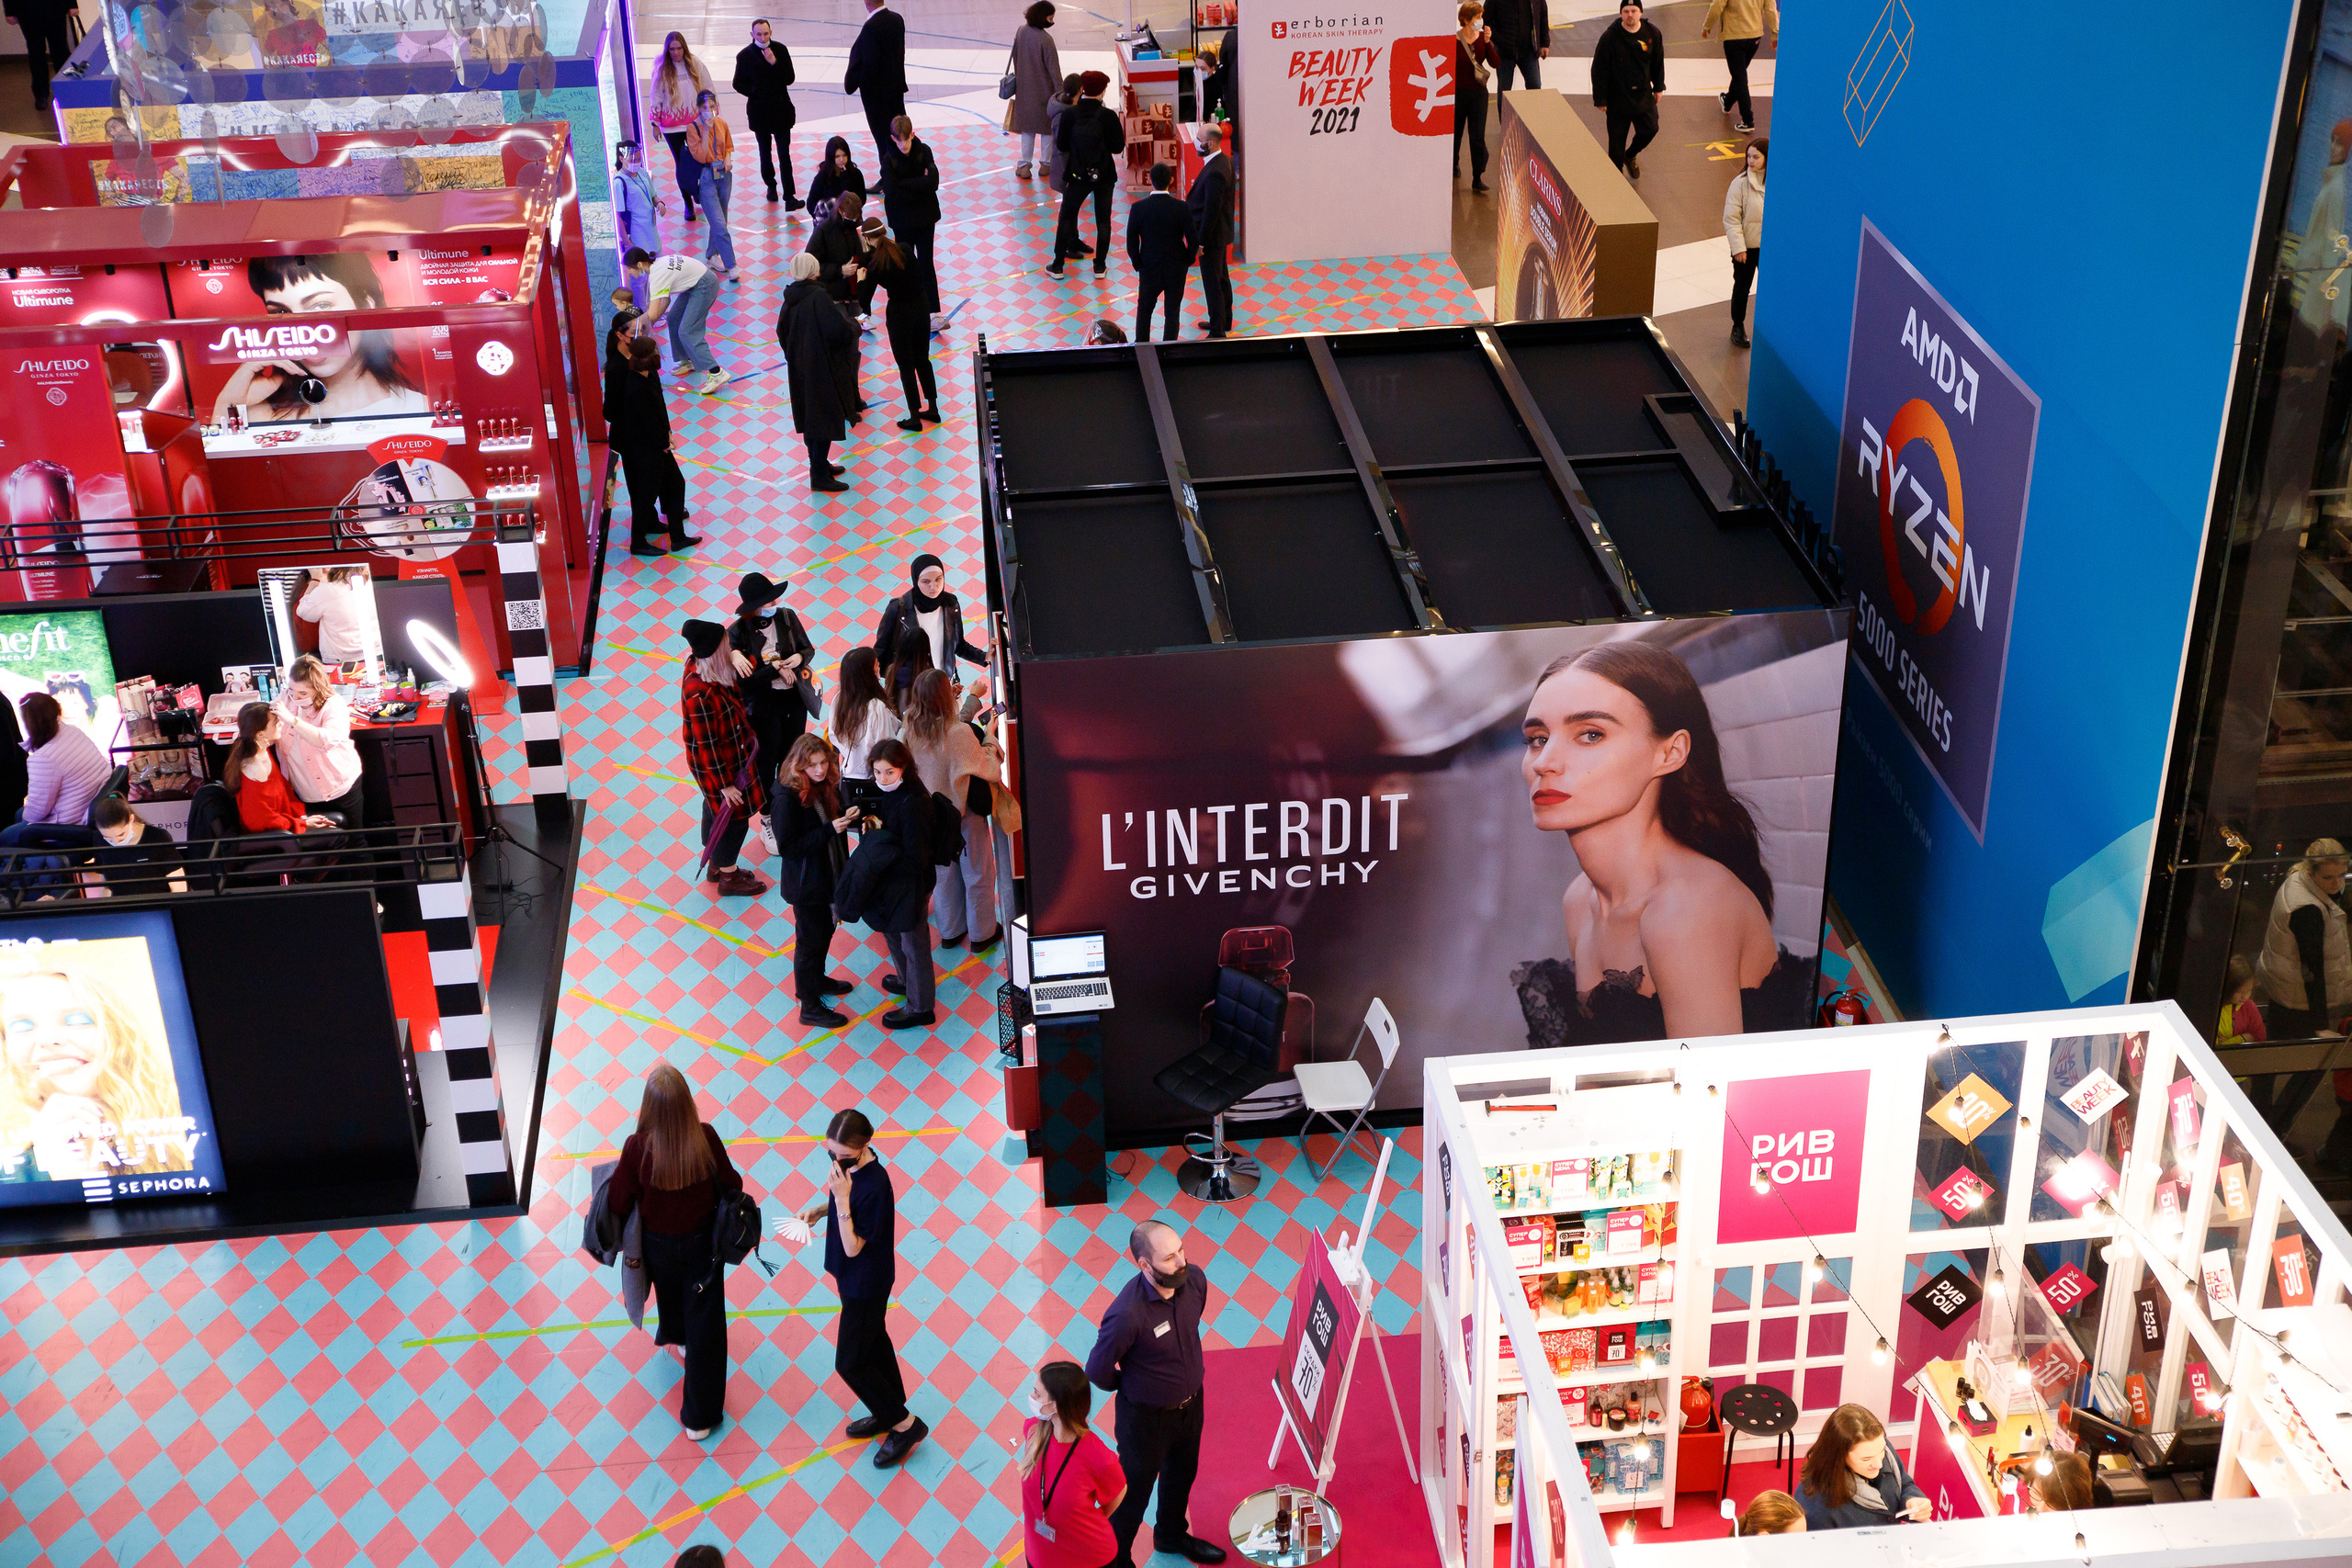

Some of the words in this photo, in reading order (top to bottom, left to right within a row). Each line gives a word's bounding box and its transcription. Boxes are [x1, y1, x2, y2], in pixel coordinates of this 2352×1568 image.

[1291, 14, 1384, 29] erborian
[1291, 31, 1323, 39] KOREAN
[1347, 28, 1384, 37] THERAPY
[1288, 47, 1383, 79] BEAUTY
[1298, 76, 1374, 107] WEEK
[1310, 107, 1360, 136] 2021
[1529, 158, 1562, 217] CLARINS
[418, 249, 469, 260] Ultimune
[420, 262, 449, 270] ДВОЙНАЯ
[426, 267, 459, 276] МОЛОДОЙ
[13, 295, 74, 308] Ultimune
[209, 324, 336, 351] SHISEIDO
[237, 347, 277, 359] GINZA
[278, 345, 319, 357] TOKYO
[1900, 306, 1957, 394] AMD
[14, 359, 90, 374] SHISEIDO
[382, 440, 432, 450] SHISEIDO
[1858, 416, 1990, 631] RYZEN
[1857, 590, 1896, 672] 5000
[1899, 641, 1952, 753] SERIES
[1102, 794, 1408, 871] L'INTERDIT
[1130, 860, 1379, 899] GIVENCHY
[2070, 1077, 2109, 1110] BEAUTY
[2077, 1085, 2117, 1115] WEEK
[1752, 1129, 1836, 1159] РИВ
[118, 1177, 210, 1194] SEPHORA
[1750, 1156, 1834, 1187] ГОШ
[1937, 1280, 1967, 1305] РИВ
[2047, 1270, 2082, 1304] -50%
[2206, 1269, 2230, 1286] BEAUTY
[2208, 1280, 2233, 1301] WEEK
[1316, 1299, 1332, 1330] РИВ
[1926, 1290, 1956, 1314] ГОШ
[1313, 1313, 1329, 1348] ГОШ
[2141, 1301, 2154, 1340] ГОШ
[2146, 1300, 2158, 1338] РИВ
